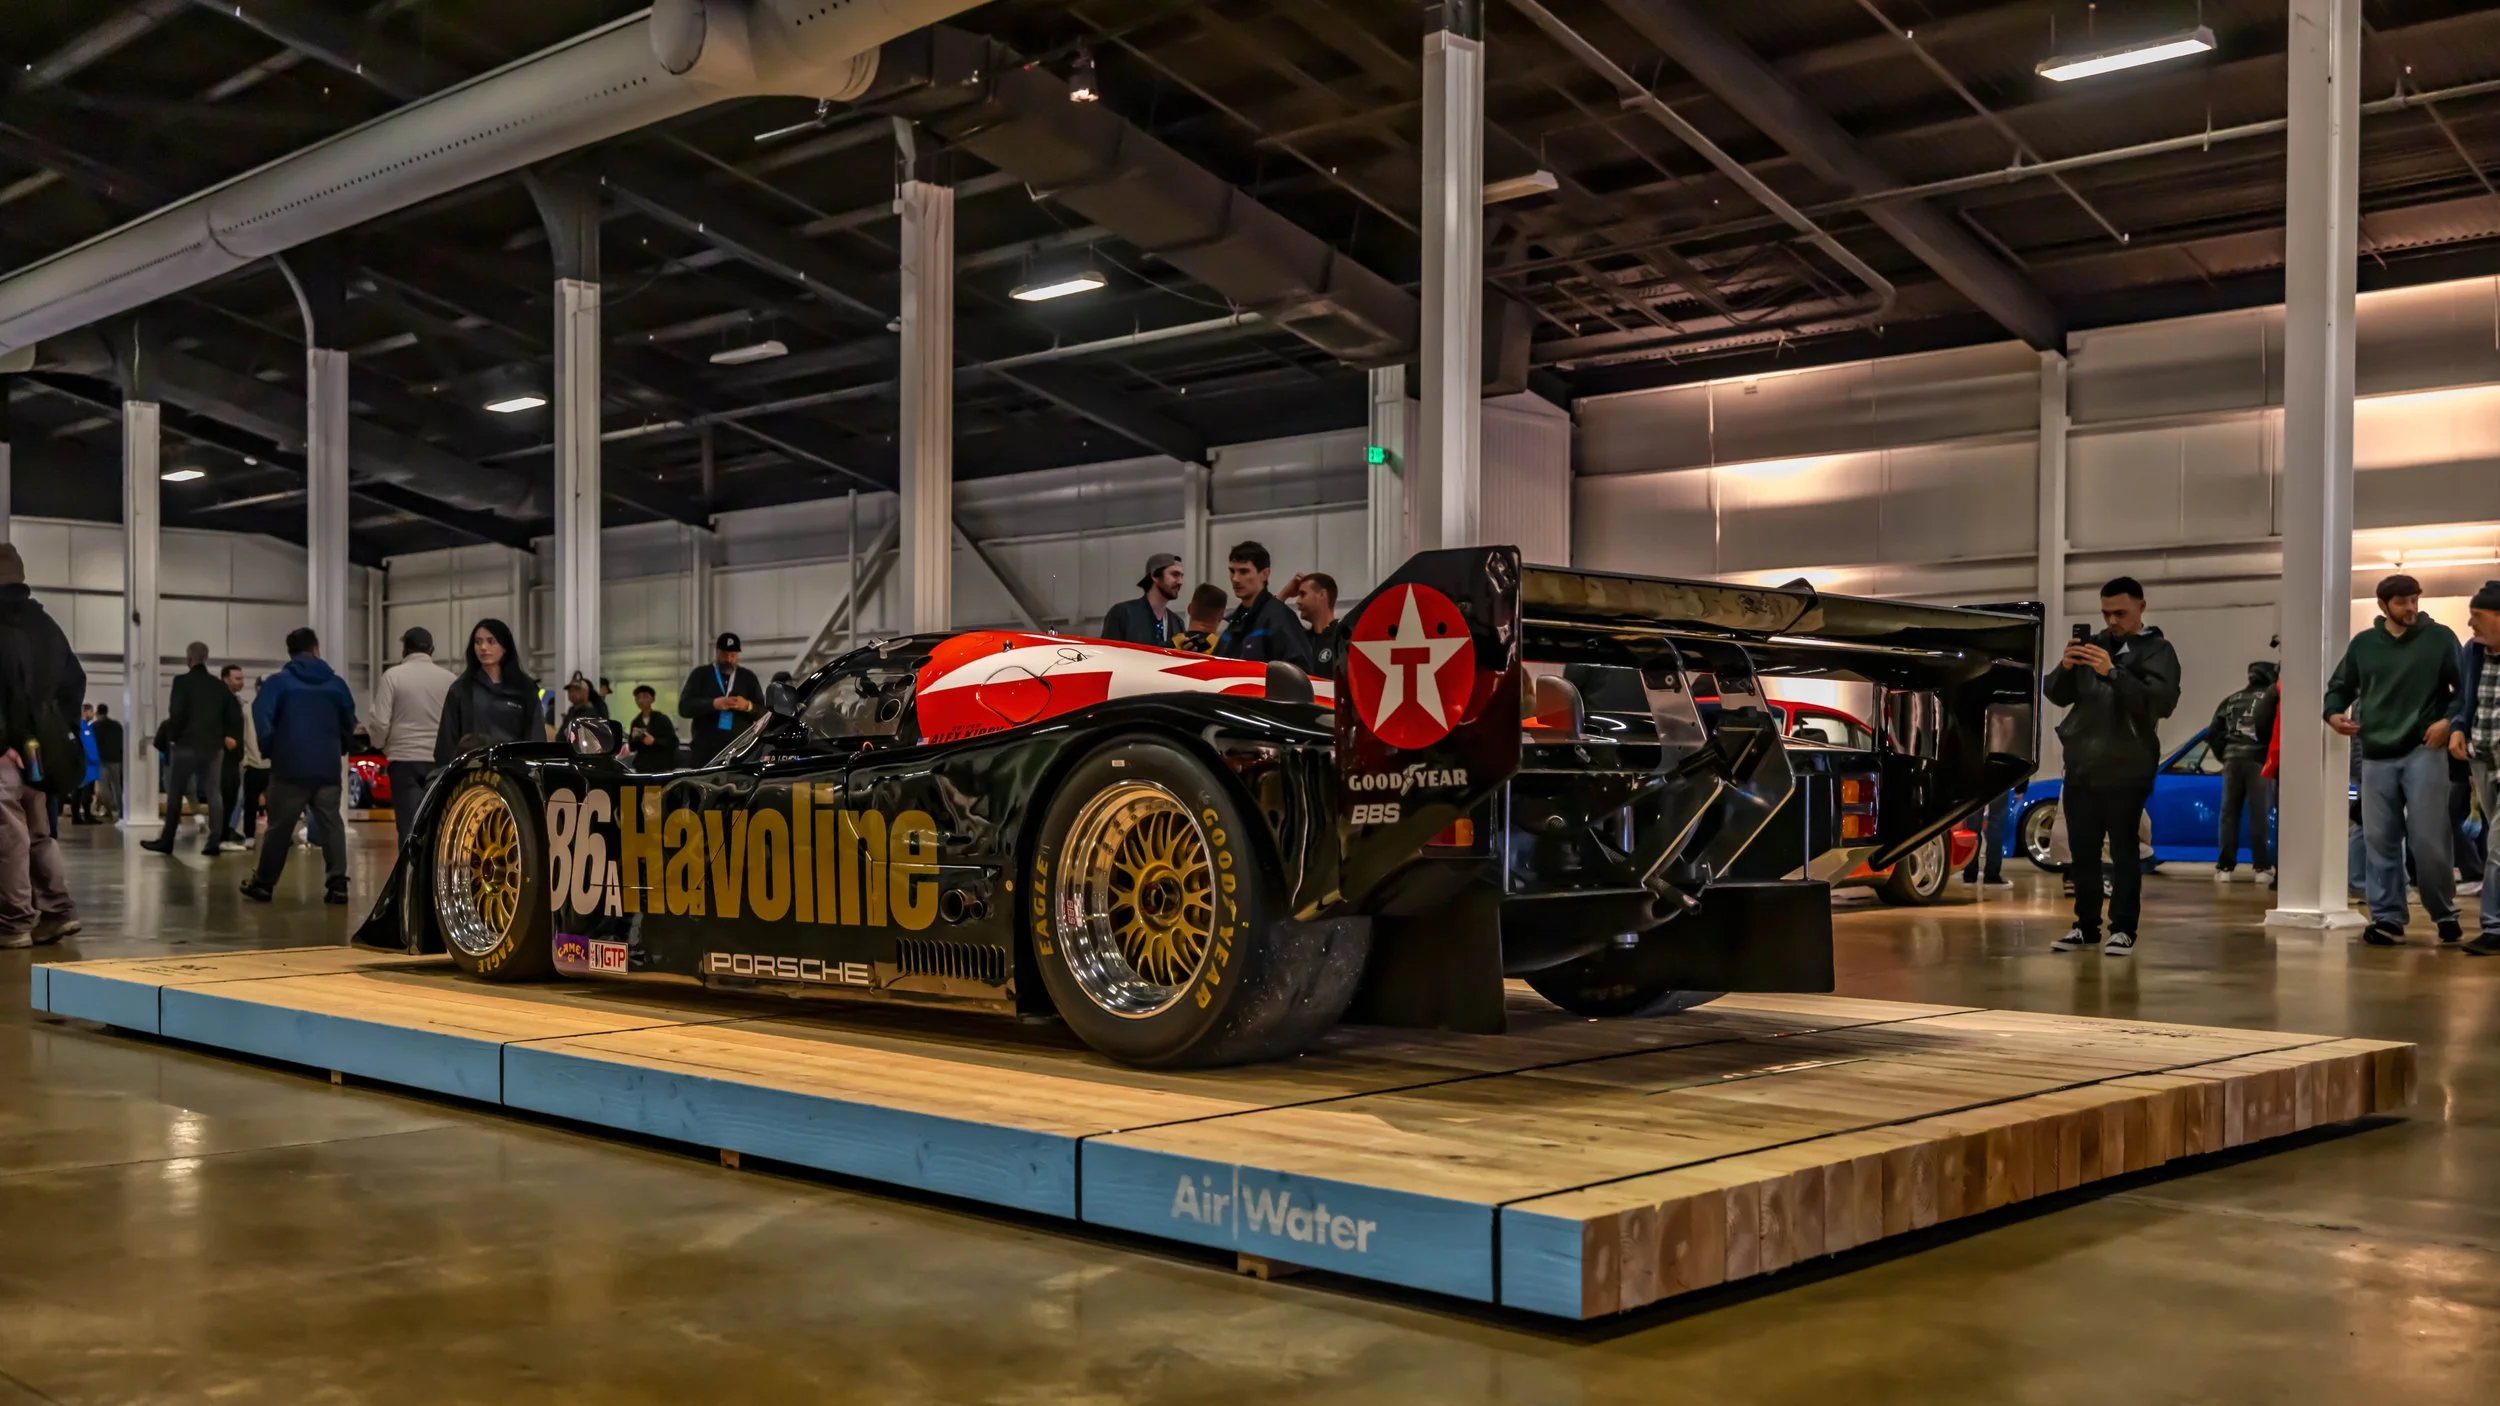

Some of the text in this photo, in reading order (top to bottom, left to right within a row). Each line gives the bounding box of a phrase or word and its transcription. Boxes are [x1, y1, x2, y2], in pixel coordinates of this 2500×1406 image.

[1351, 803, 1399, 824] BBS
[620, 783, 940, 931] Havoline
[1034, 855, 1054, 956] EAGLE
[1067, 900, 1077, 925] BBS
[477, 935, 514, 973] EAGLE
[557, 943, 586, 960] CAMEL
[604, 947, 625, 968] GTP
[711, 952, 869, 985] PORSCHE
